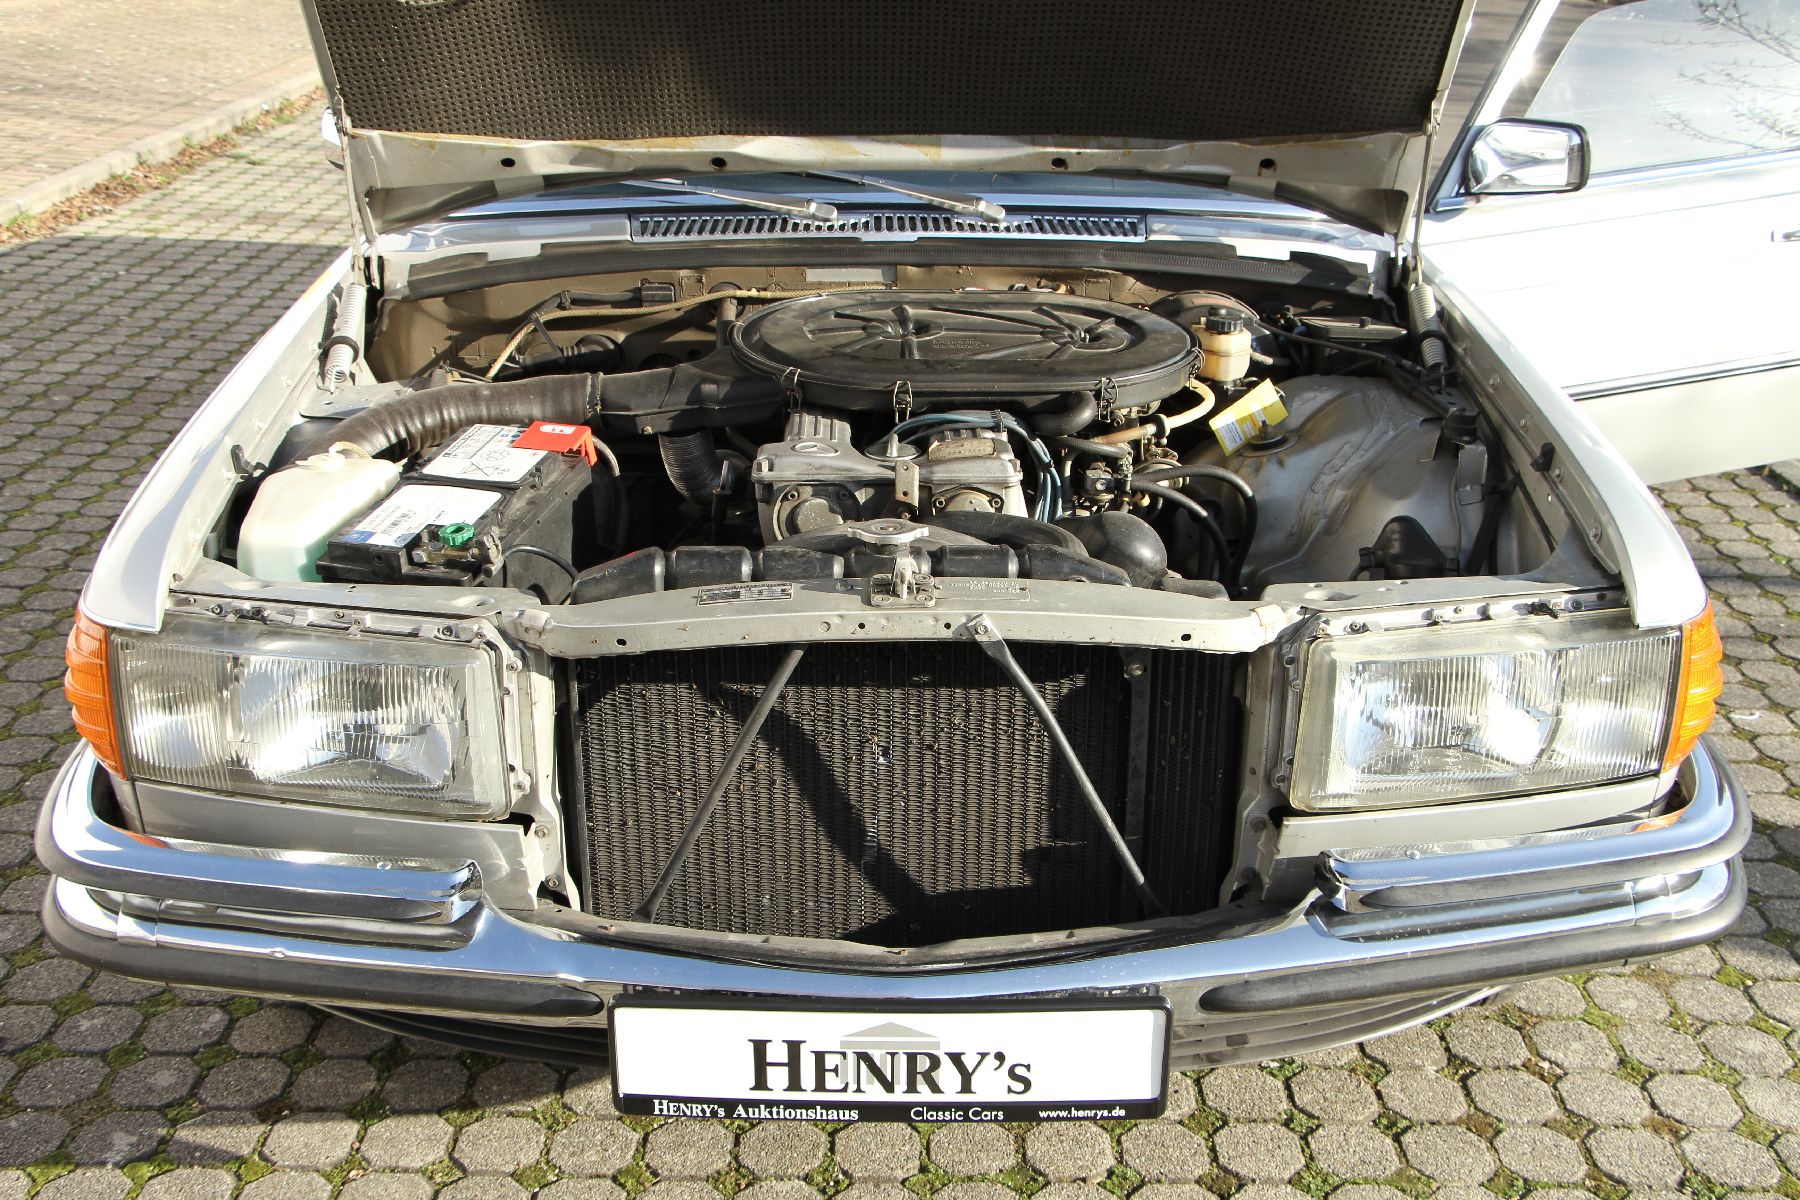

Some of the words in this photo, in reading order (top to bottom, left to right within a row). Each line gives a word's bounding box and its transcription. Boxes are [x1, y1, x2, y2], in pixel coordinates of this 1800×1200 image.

[747, 1038, 1033, 1095] HENRY’s
[732, 1103, 860, 1121] Auktionshaus
[910, 1106, 964, 1121] Classic
[968, 1106, 1005, 1121] Cars
[1038, 1105, 1126, 1119] www.henrys.de
